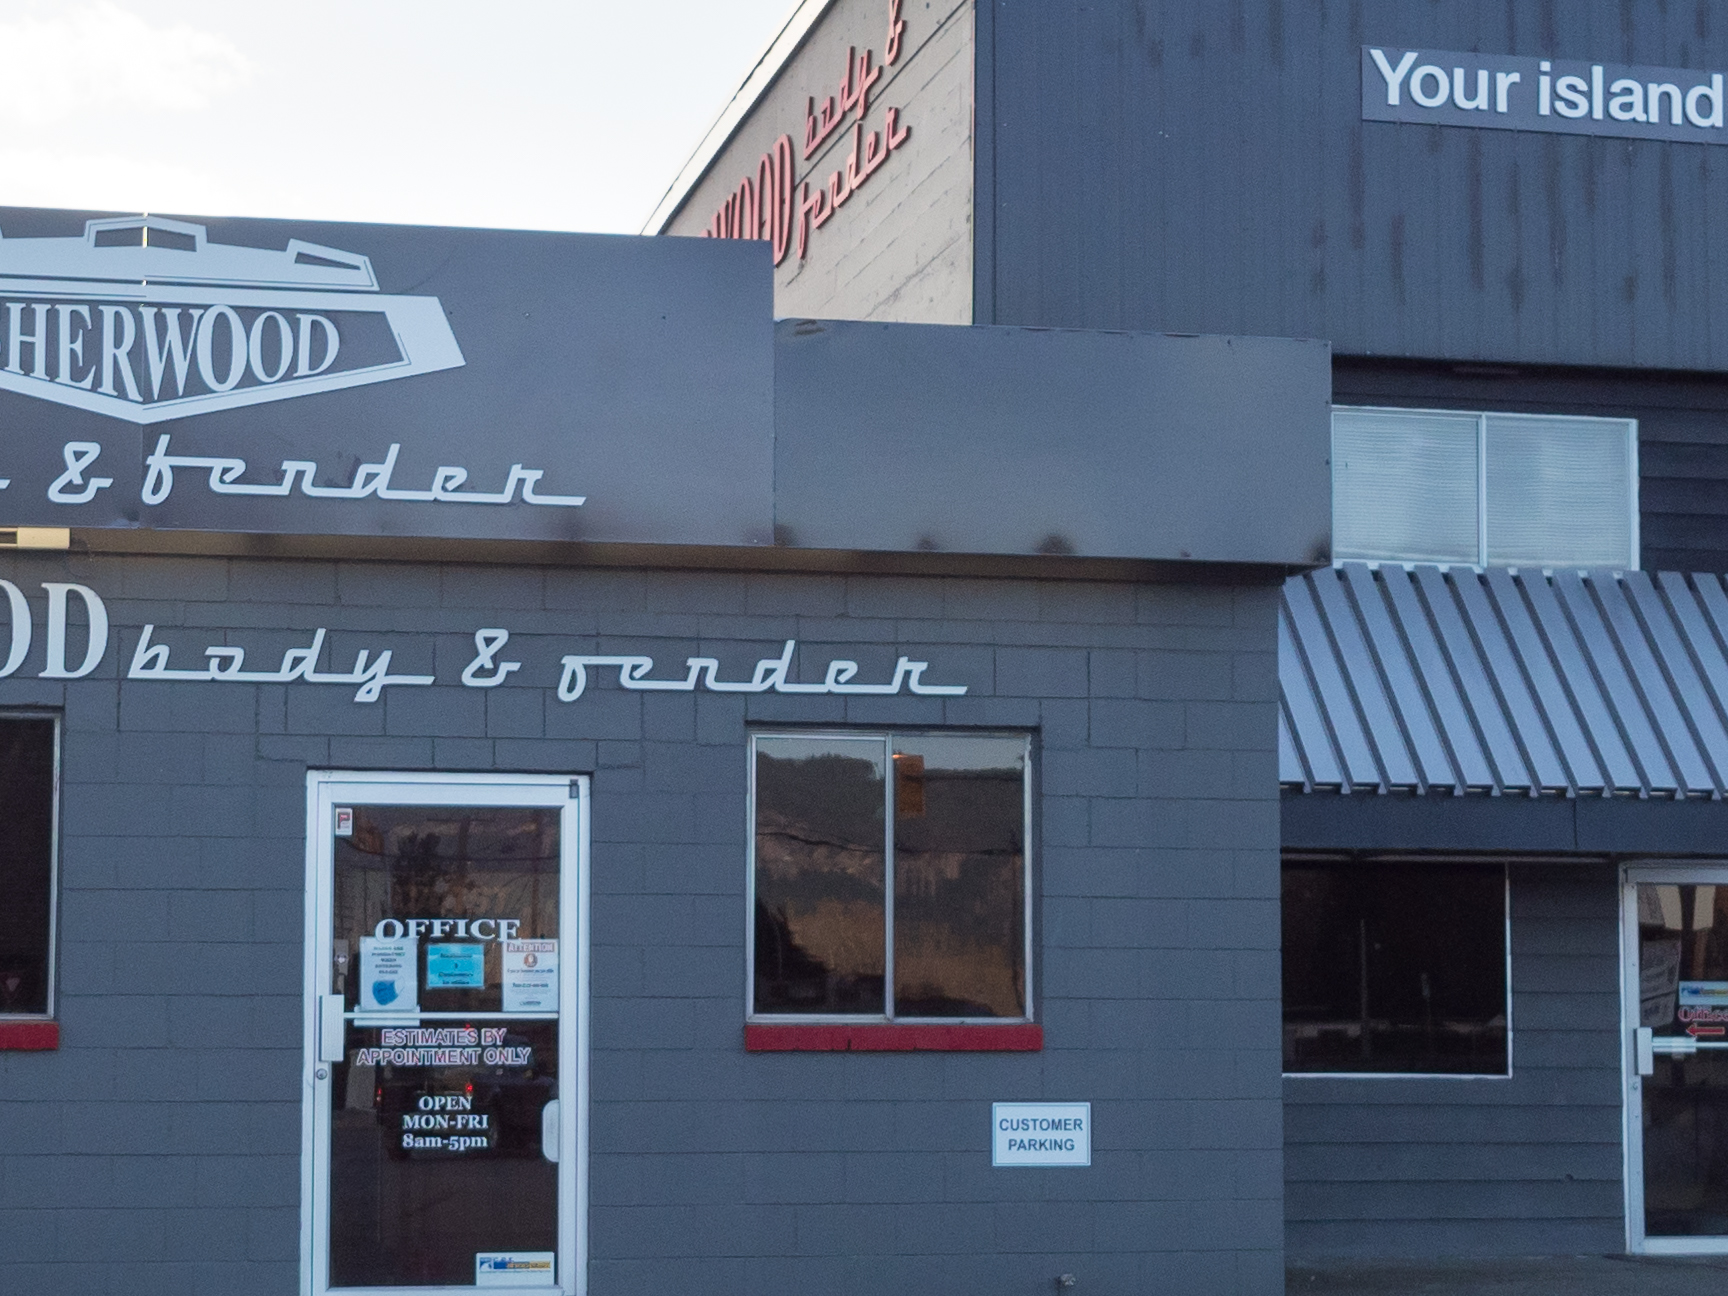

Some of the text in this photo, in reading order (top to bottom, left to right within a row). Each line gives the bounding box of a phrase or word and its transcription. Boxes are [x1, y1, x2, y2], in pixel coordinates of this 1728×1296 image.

[1369, 48, 1521, 114] Your
[1538, 60, 1725, 129] island
[804, 46, 883, 161] body
[797, 106, 912, 260] fender
[46, 440, 114, 504] &
[141, 433, 587, 506] fender
[126, 623, 436, 703] body
[461, 628, 521, 687] &
[557, 639, 969, 702] fender
[375, 918, 522, 942] OFFICE
[382, 1028, 507, 1046] ESTIMATES BY
[356, 1047, 531, 1065] APPOINTMENT ONLY
[419, 1095, 472, 1110] OPEN
[402, 1114, 489, 1129] MON-FRI
[999, 1118, 1083, 1131] CUSTOMER
[402, 1133, 488, 1150] 8am-5pm
[1008, 1138, 1075, 1151] PARKING
